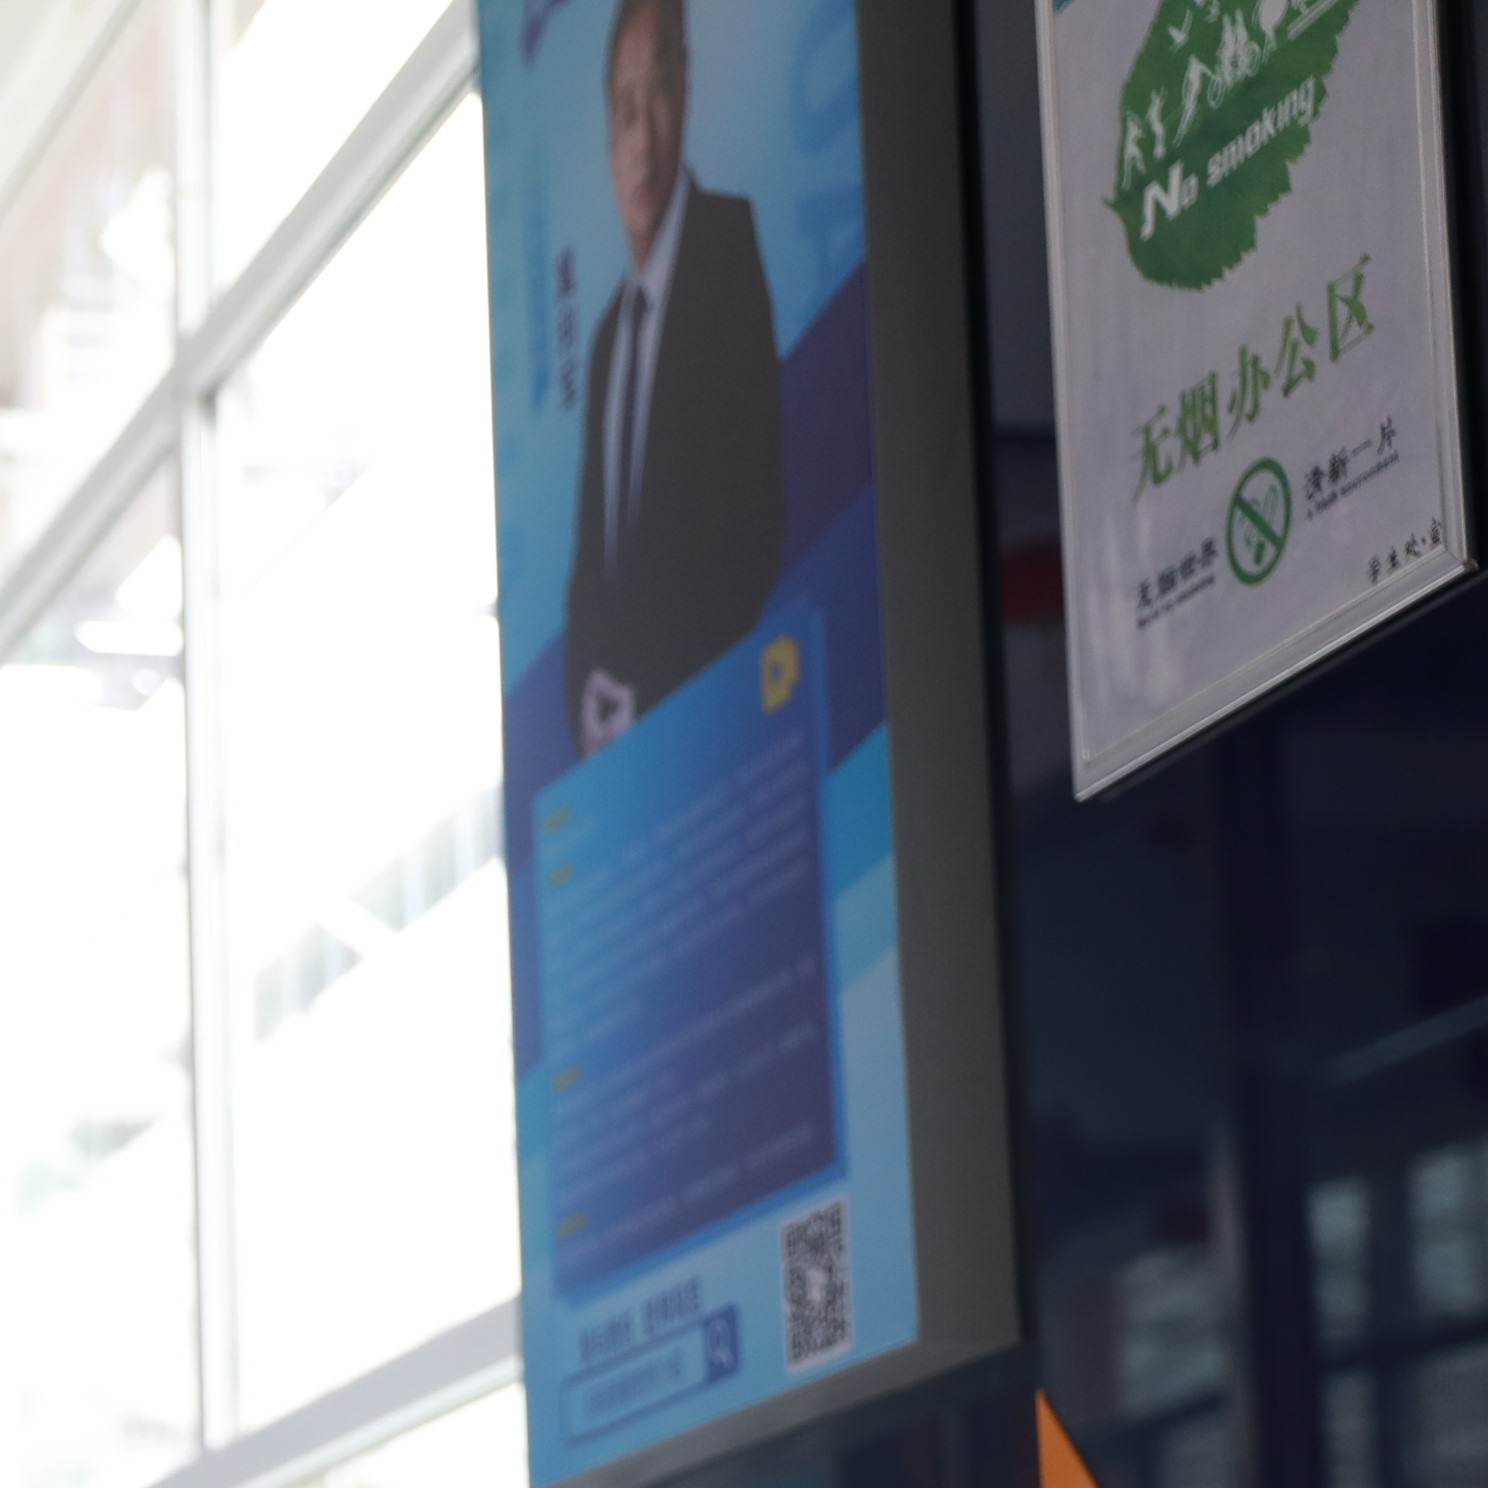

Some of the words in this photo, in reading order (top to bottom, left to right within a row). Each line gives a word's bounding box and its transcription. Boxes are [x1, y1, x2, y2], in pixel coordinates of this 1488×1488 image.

[1140, 158, 1200, 241] No
[1207, 75, 1317, 188] smoking
[1130, 253, 1375, 503] 无烟办公区
